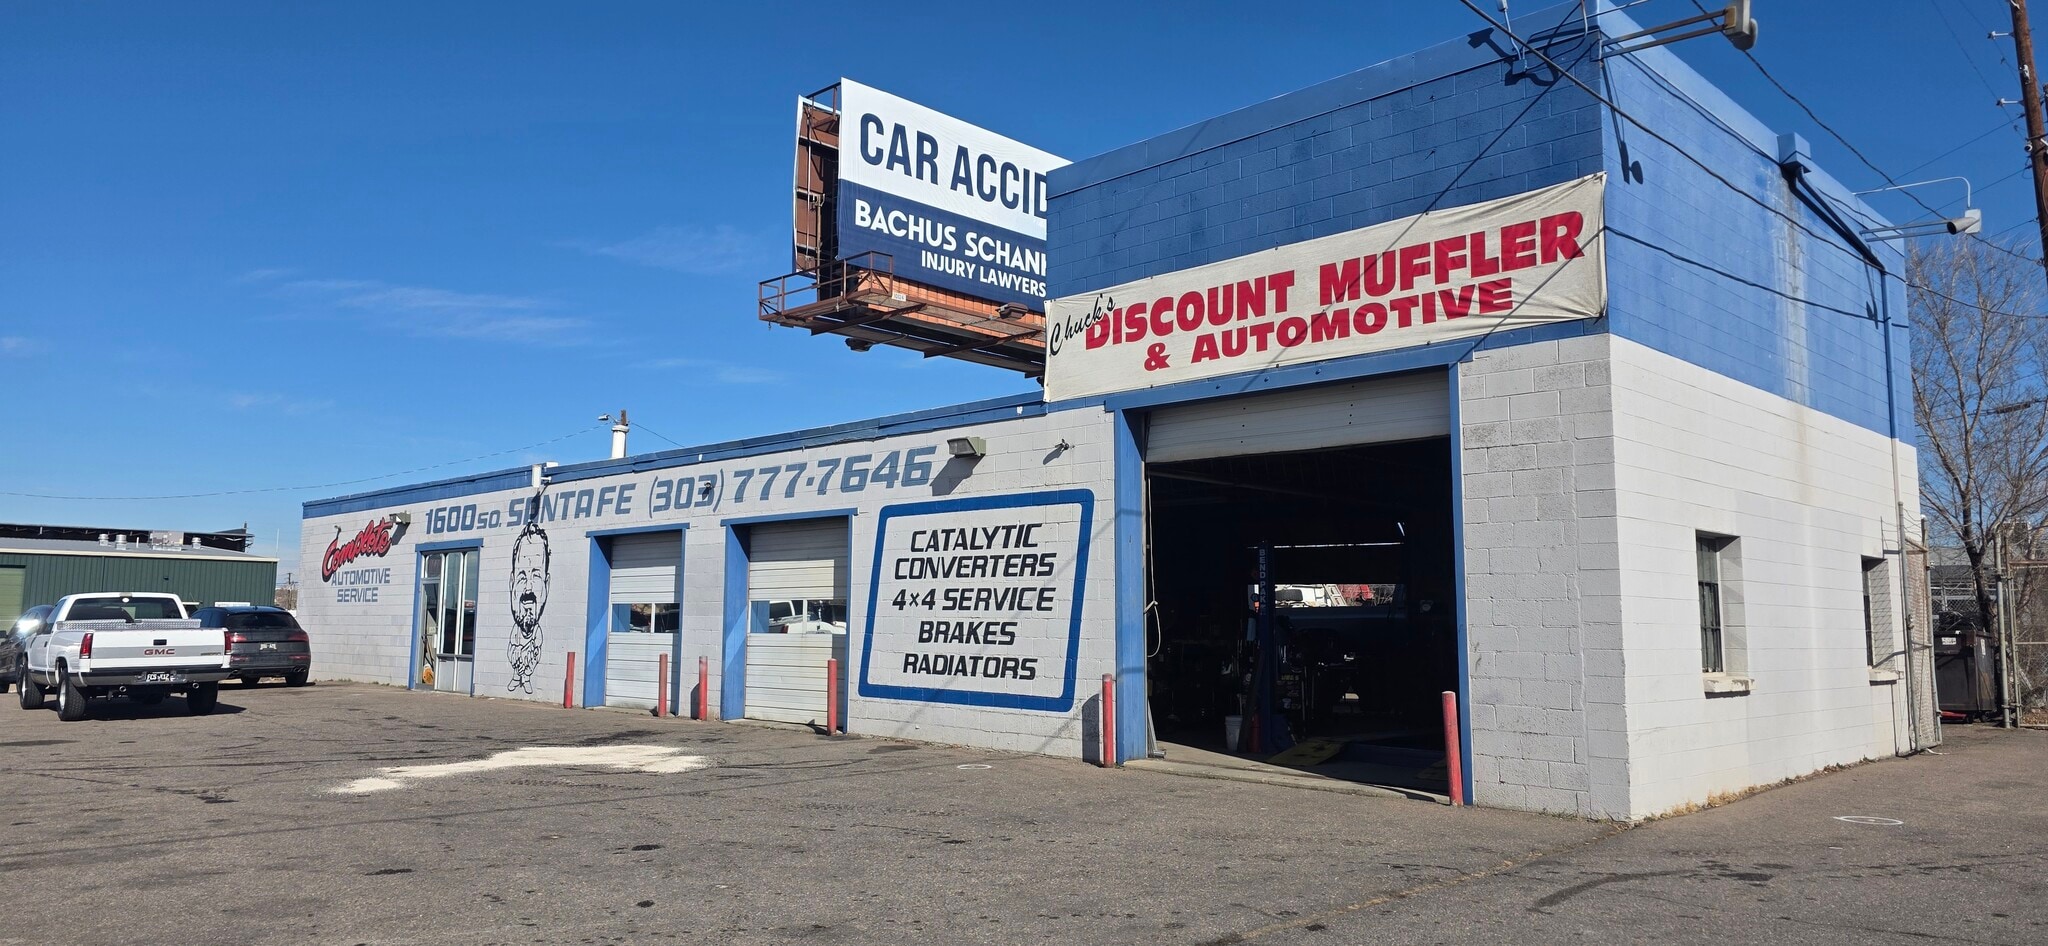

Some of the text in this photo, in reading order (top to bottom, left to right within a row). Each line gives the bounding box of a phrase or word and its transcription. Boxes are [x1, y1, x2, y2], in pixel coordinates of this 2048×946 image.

[859, 112, 1047, 220] CAR ACCID
[854, 198, 957, 252] BACHUS
[921, 250, 1047, 298] INJURY LAWYERS
[1086, 210, 1585, 350] DISCOUNT MUFFLER
[1050, 293, 1116, 356] Chuck's
[1144, 277, 1513, 372] & AUTOMOTIVE
[648, 468, 724, 519] (303)
[425, 503, 477, 535] 1600
[322, 517, 393, 583] Complete
[910, 523, 1042, 553] CATALYTIC
[331, 567, 391, 586] AUTOMOTIVE
[894, 553, 1057, 580] CONVERTERS
[337, 587, 379, 603] SERVICE
[942, 587, 1056, 611] SERVICE
[918, 621, 1018, 645] BRAKES
[144, 648, 175, 656] GMC
[903, 653, 1038, 680] RADIATORS
